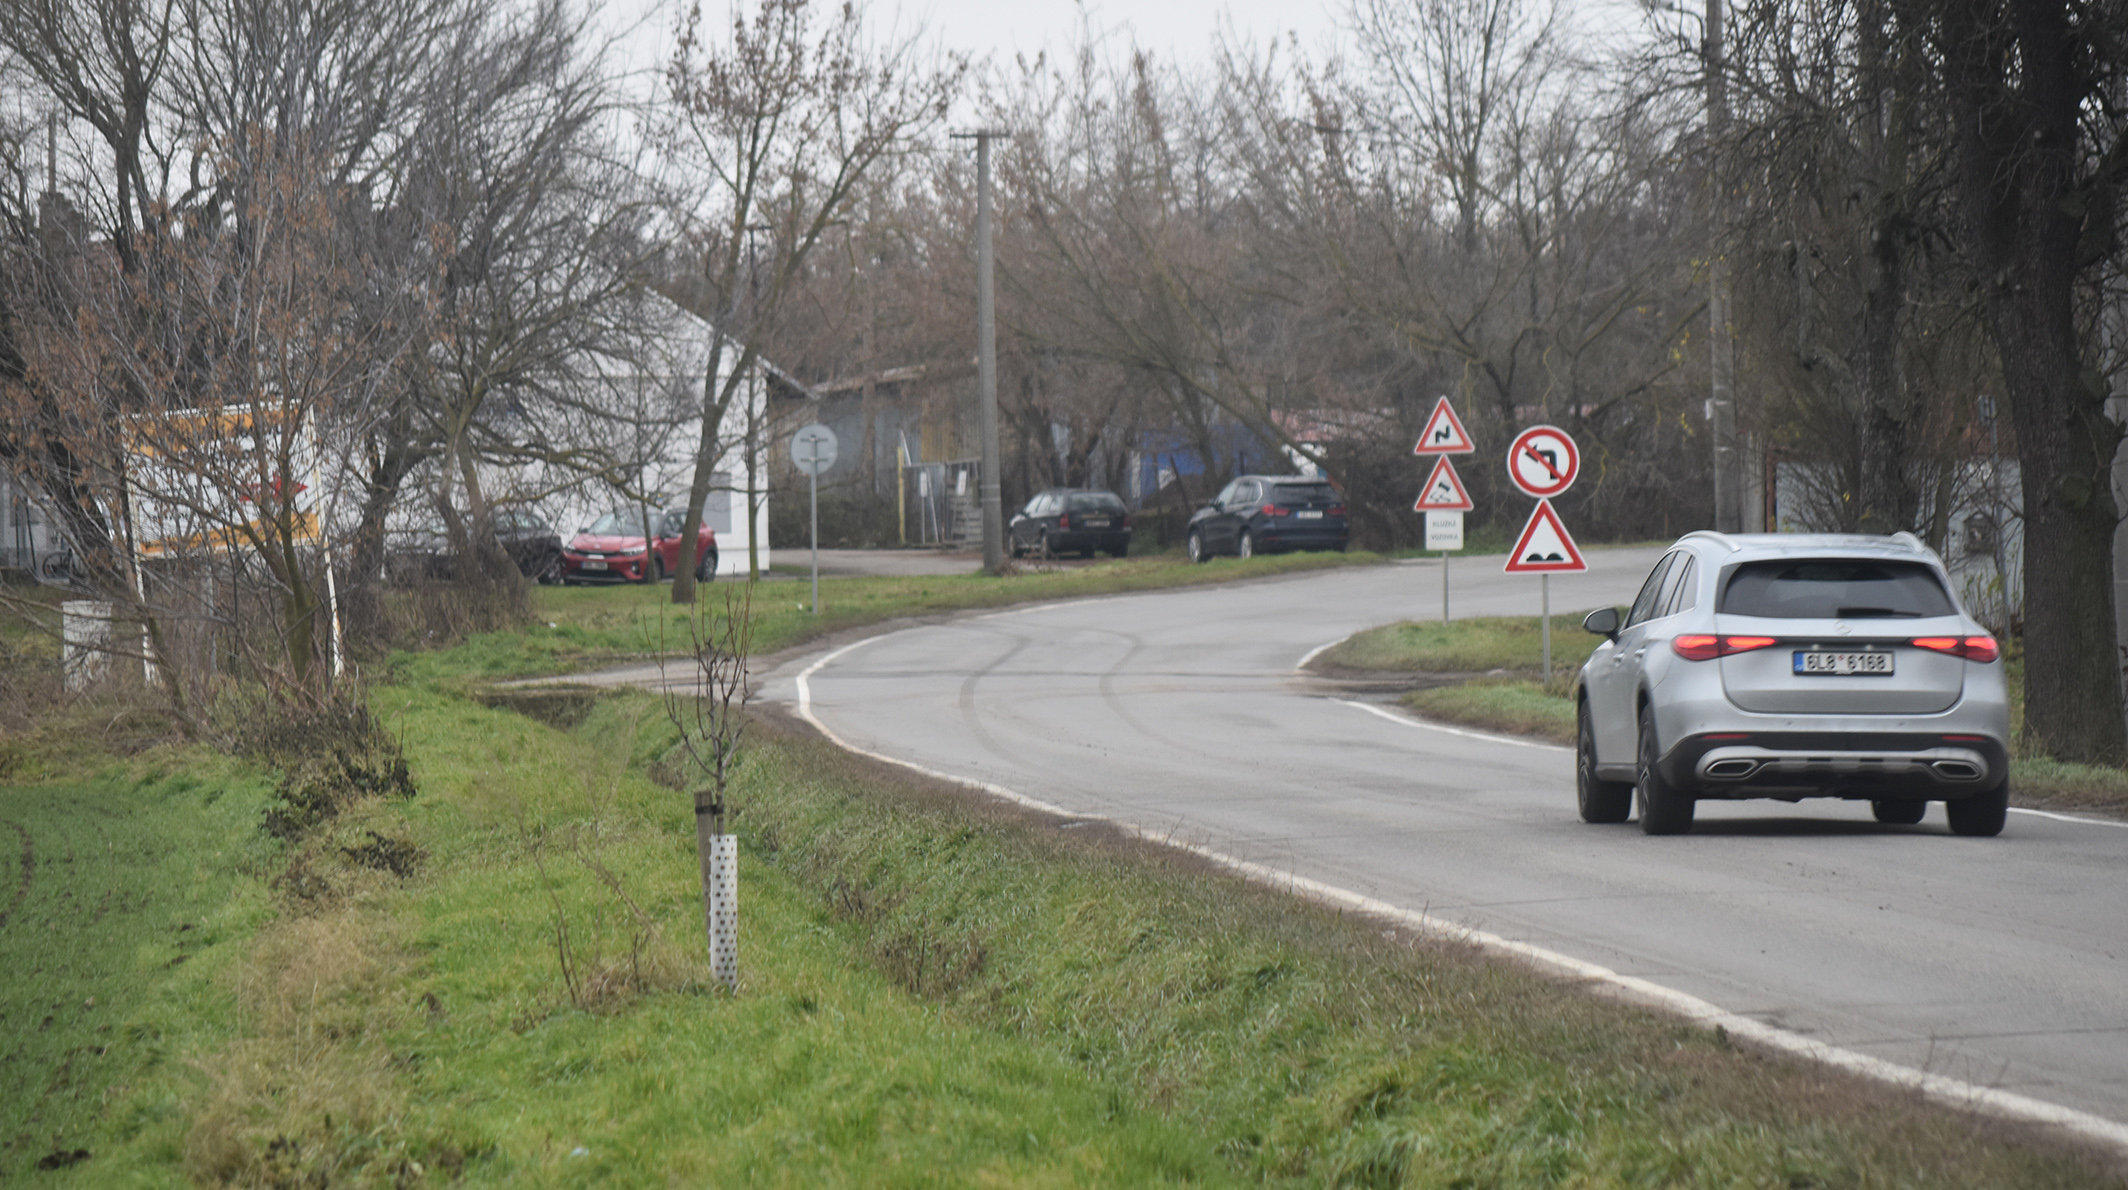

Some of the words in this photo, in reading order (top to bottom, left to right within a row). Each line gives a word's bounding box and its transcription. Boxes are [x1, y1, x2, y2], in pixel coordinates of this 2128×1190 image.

[1432, 519, 1457, 528] KLUZKÁ
[1431, 533, 1459, 541] VOZOVKA
[1807, 654, 1836, 670] 6L8
